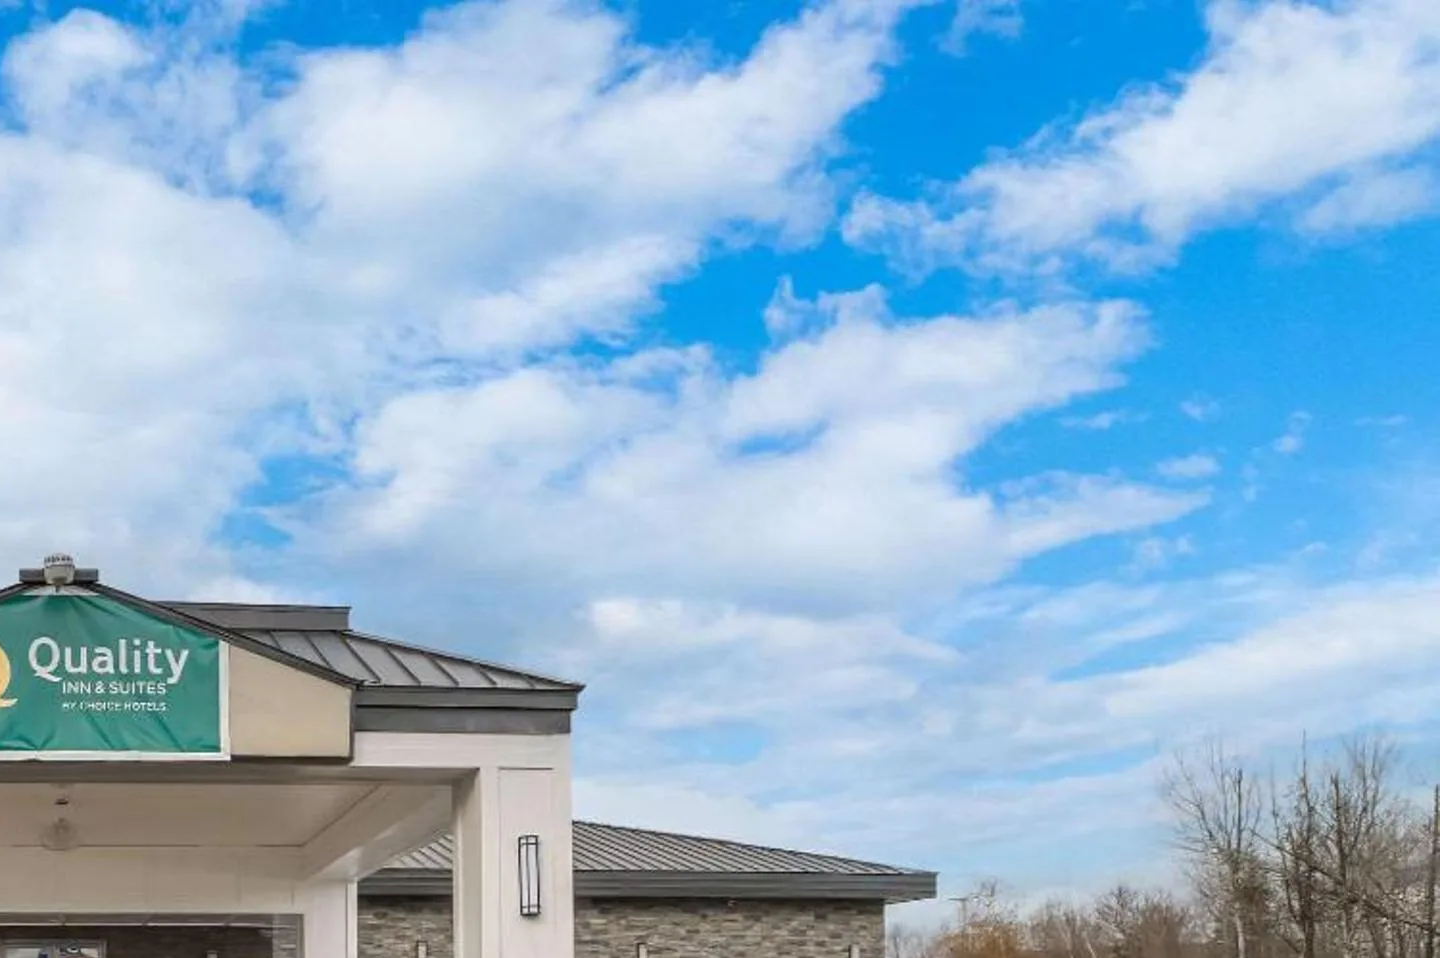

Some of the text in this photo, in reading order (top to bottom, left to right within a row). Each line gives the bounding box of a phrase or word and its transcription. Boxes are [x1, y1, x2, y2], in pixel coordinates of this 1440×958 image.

[28, 636, 189, 684] Quality
[62, 681, 167, 695] INN & SUITES
[80, 702, 121, 711] CHOICE
[124, 702, 167, 711] HOTELS
